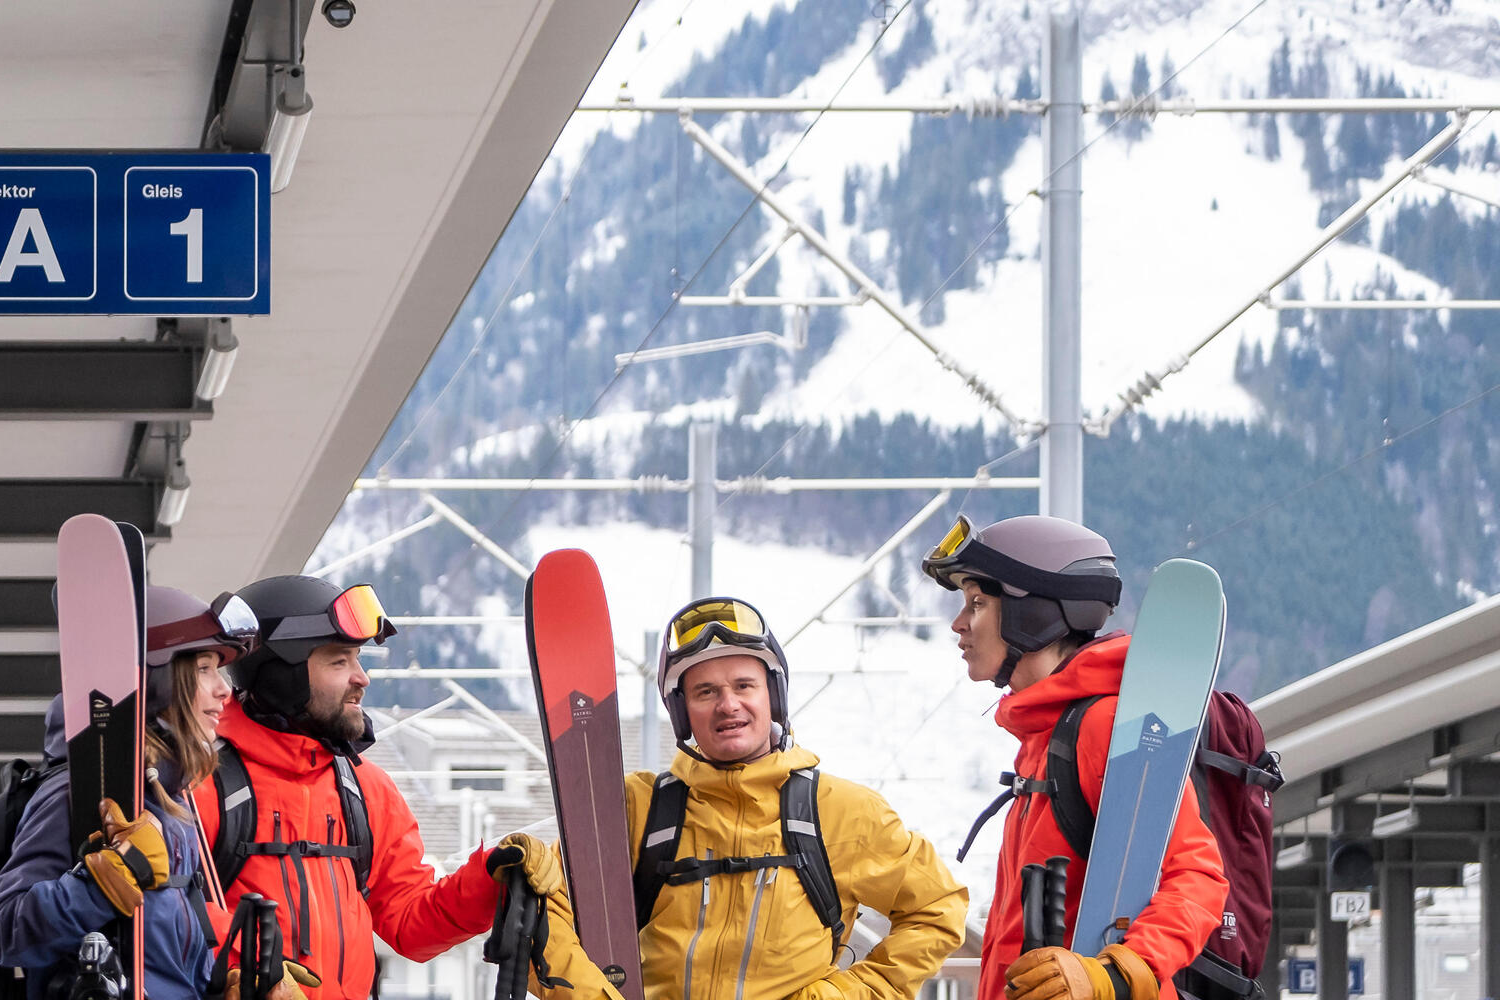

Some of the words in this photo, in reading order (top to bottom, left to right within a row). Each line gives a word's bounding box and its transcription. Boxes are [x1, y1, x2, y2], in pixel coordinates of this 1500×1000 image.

[142, 184, 183, 199] Gleis
[170, 208, 203, 283] 1
[1335, 896, 1366, 913] FB2
[1300, 969, 1316, 988] B
